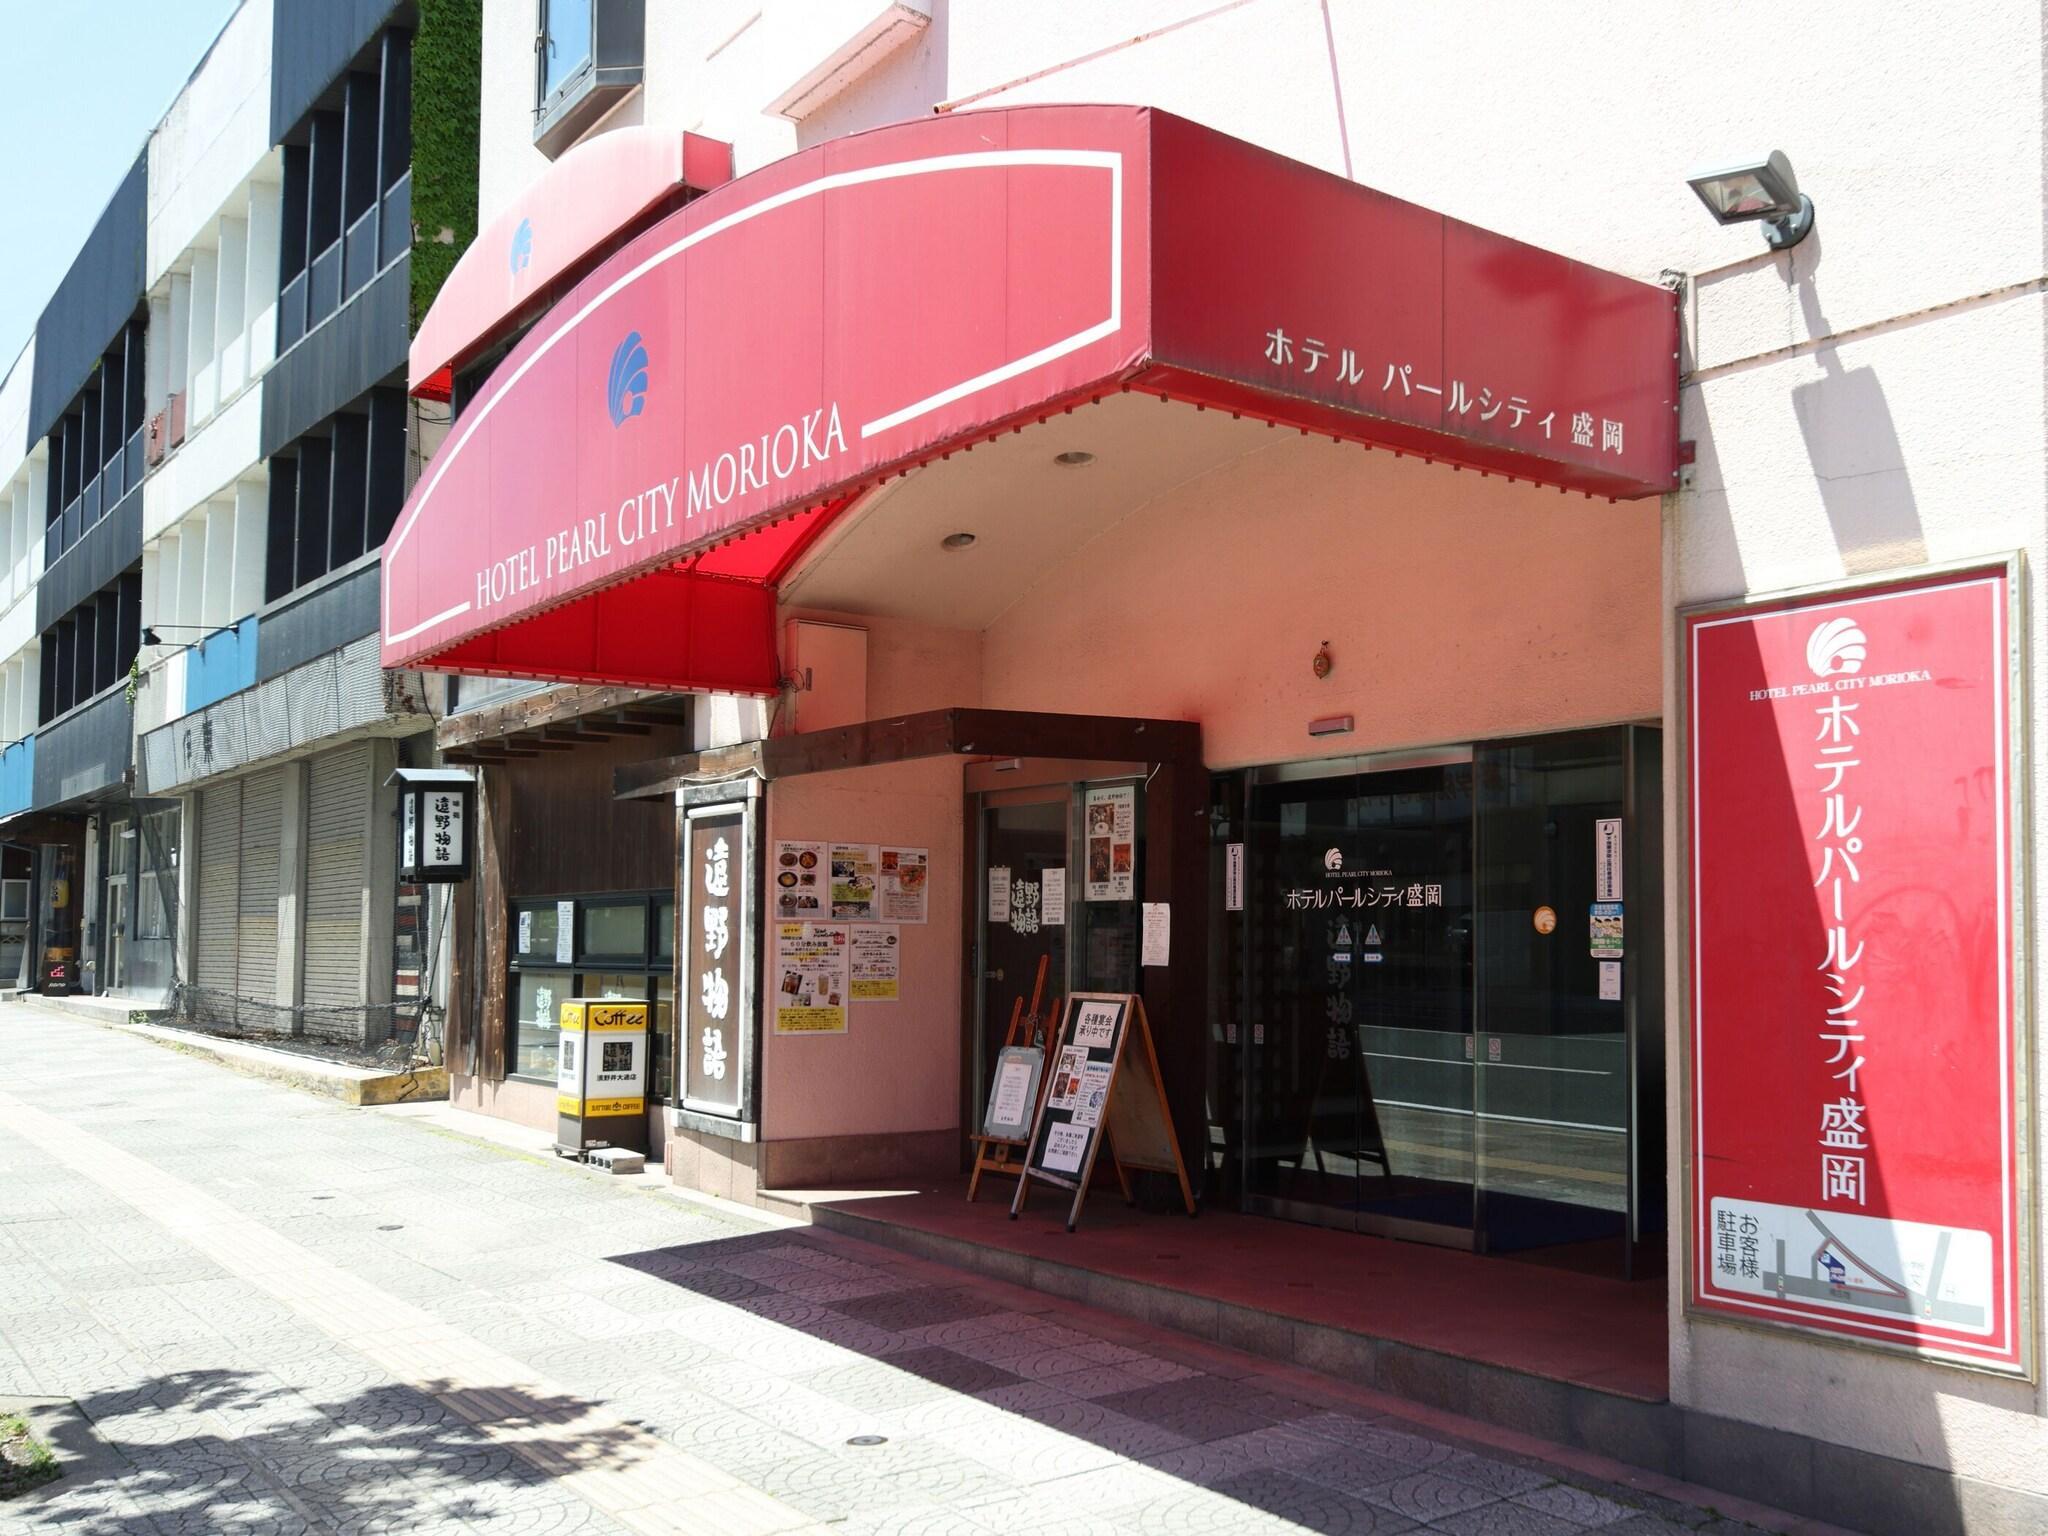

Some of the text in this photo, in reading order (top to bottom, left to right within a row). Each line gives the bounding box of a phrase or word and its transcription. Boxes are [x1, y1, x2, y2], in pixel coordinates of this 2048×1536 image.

[1264, 328, 1365, 385] ホテル
[476, 401, 848, 610] HOTEL PEARL CITY MORIOKA
[1750, 669, 1932, 701] HOTEL PEARL CITY MORIOKA
[1286, 883, 1442, 910] ホテルパールシティ盛岡
[701, 837, 729, 1080] 遠野物語
[1814, 695, 1868, 1206] ホテルパールシティ盛岡
[594, 1009, 644, 1027] Coffee
[1079, 1024, 1112, 1039] 承り中です
[1084, 1012, 1113, 1027] 各種宴会
[1717, 1210, 1737, 1276] 駐車場
[1739, 1213, 1759, 1279] お客様
